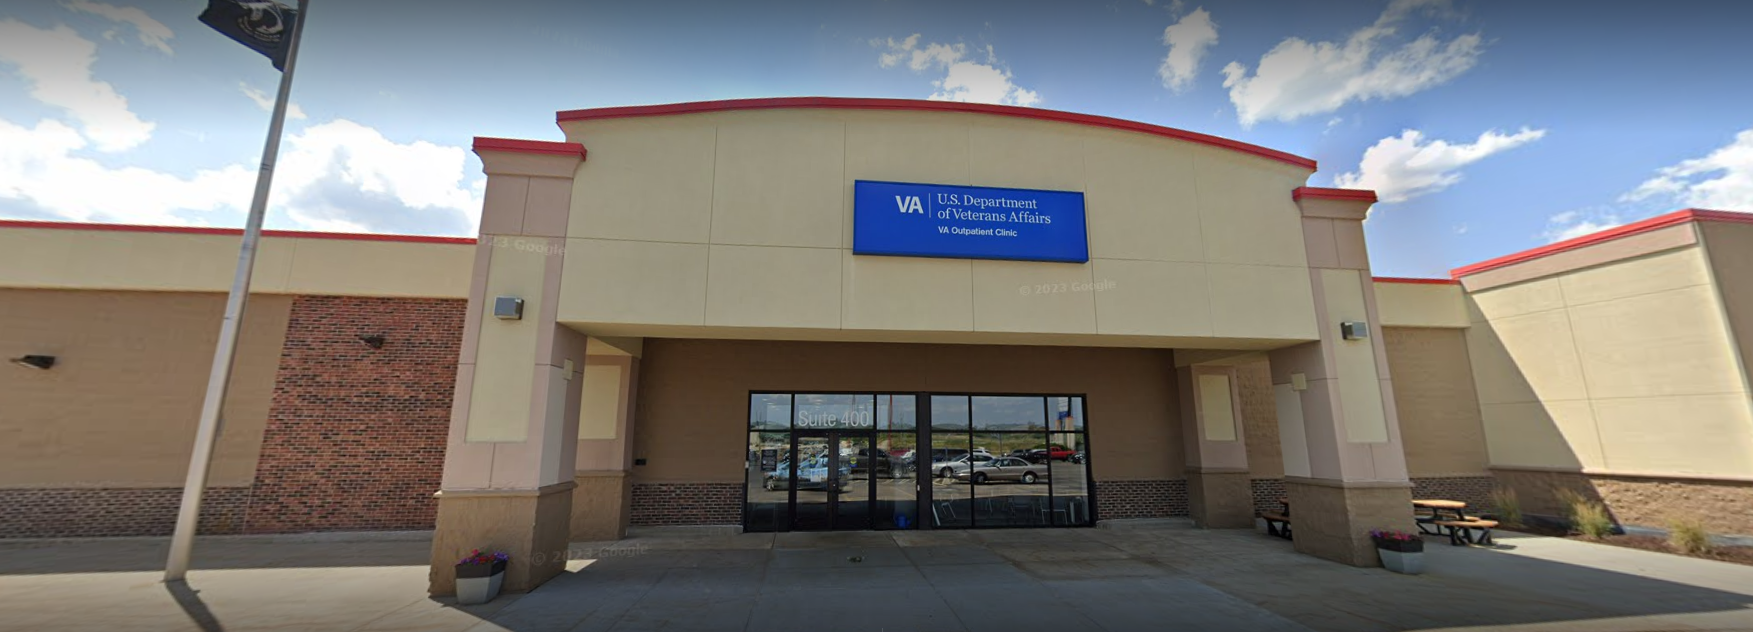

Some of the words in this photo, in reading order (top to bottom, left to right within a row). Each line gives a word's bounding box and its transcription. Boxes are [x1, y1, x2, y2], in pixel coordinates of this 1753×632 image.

[894, 195, 924, 214] VA
[937, 193, 961, 205] U.S.
[963, 194, 1038, 209] Department
[937, 207, 951, 219] of
[952, 208, 1006, 222] Veterans
[1008, 211, 1051, 224] Affairs
[938, 226, 949, 234] VA
[951, 226, 994, 236] Outpatient
[995, 228, 1018, 237] Clinic
[798, 410, 837, 427] Suite
[840, 410, 869, 427] 400
